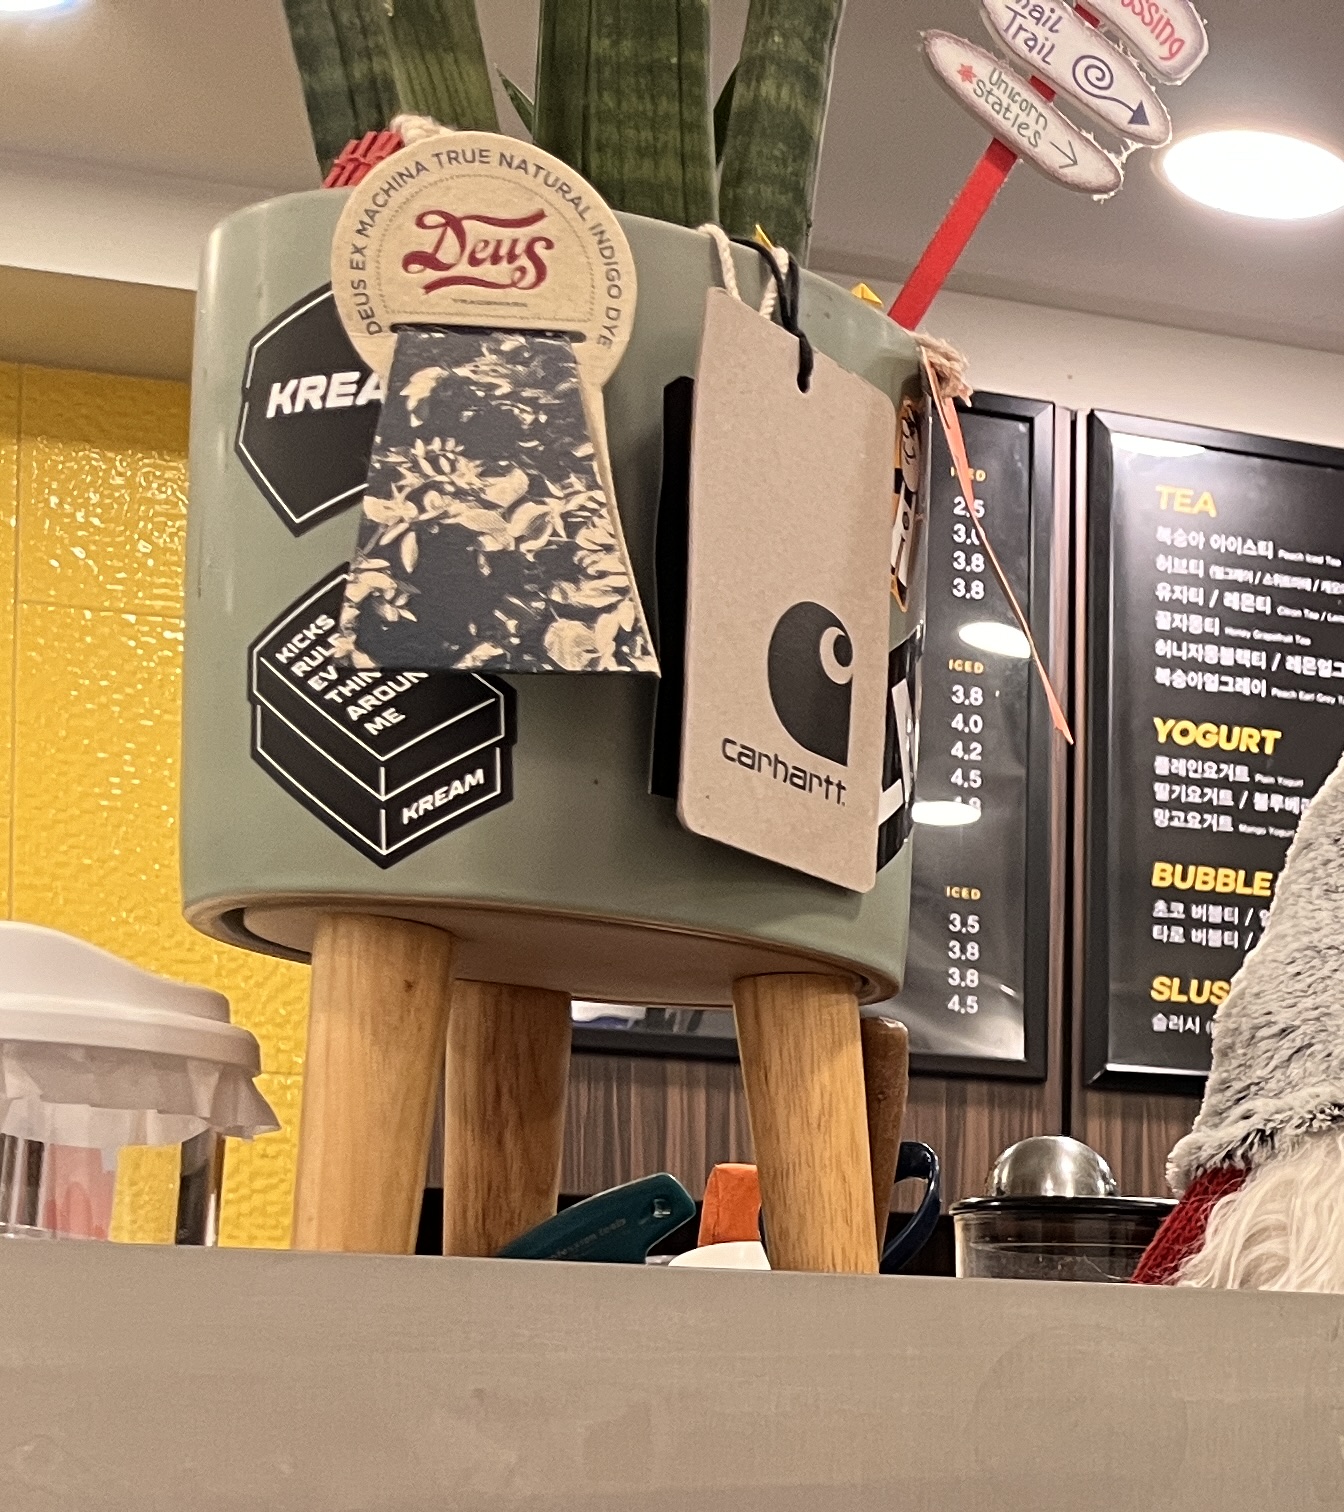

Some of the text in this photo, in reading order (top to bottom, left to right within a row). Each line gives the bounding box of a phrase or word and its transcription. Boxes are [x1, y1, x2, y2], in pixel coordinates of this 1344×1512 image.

[1002, 6, 1056, 65] Trail
[989, 67, 1048, 131] Unicorn
[350, 149, 623, 350] DEUS EX MACHINA TRUE NATURAL INDIGO DYE
[402, 208, 555, 294] Deus
[266, 371, 385, 418] KREA
[1155, 484, 1217, 518] TEA
[1210, 534, 1274, 559] 아이스티
[953, 551, 985, 573] 3.8
[1156, 553, 1204, 578] 허브티
[952, 578, 985, 600] 3.8
[1155, 582, 1204, 605] 유자티
[275, 614, 335, 664] KICKS
[949, 659, 984, 674] ICED
[346, 670, 429, 721] AROUN
[951, 684, 984, 706] 3.8
[364, 707, 406, 735] ME
[950, 713, 983, 734] 4.0
[1153, 717, 1282, 755] YOGURT
[950, 741, 983, 762] 4.2
[950, 768, 983, 788] 4.5
[402, 769, 485, 825] KREAM
[1151, 862, 1272, 897] BUBBLE
[945, 886, 981, 901] ICED
[948, 913, 980, 934] 3.5
[948, 940, 980, 961] 3.8
[947, 967, 979, 988] 3.8
[1150, 976, 1231, 1006] SLUS
[947, 995, 979, 1015] 4.5
[1152, 1012, 1200, 1034] 슬러시
